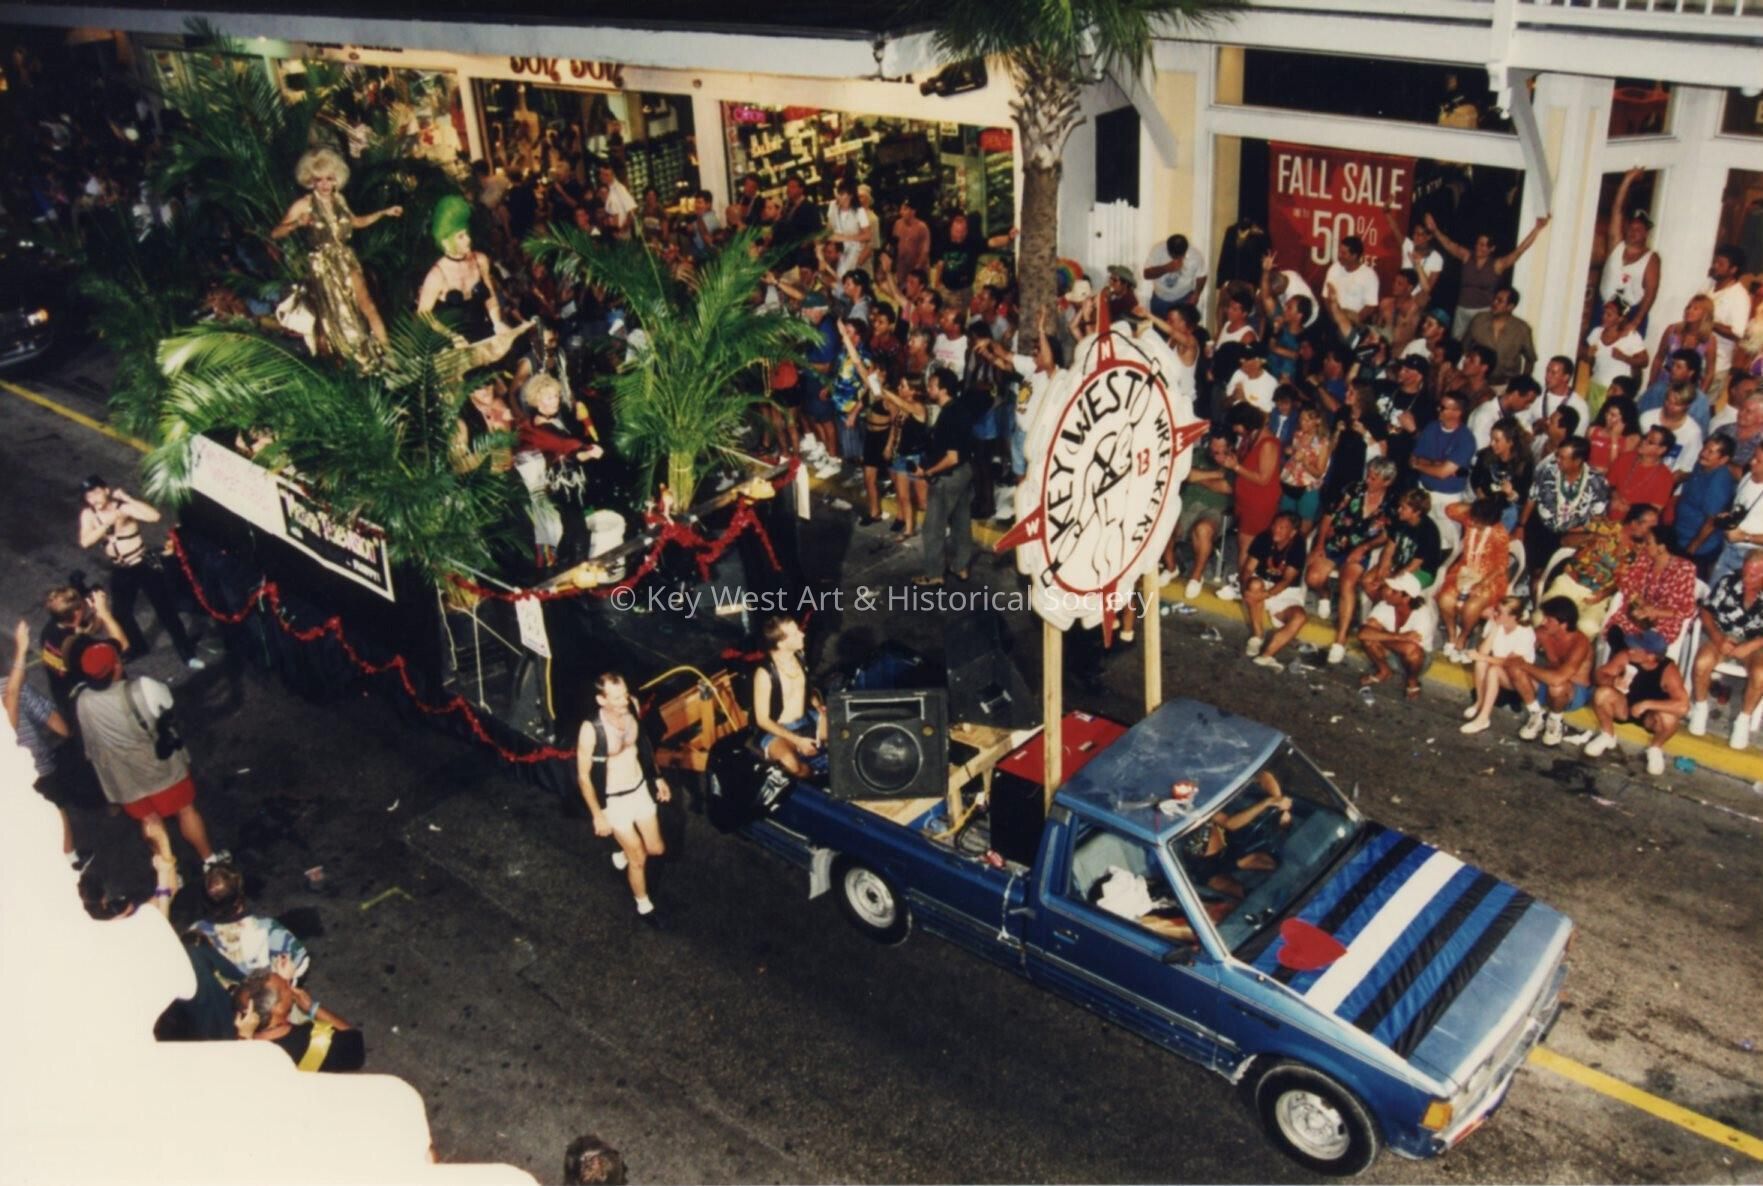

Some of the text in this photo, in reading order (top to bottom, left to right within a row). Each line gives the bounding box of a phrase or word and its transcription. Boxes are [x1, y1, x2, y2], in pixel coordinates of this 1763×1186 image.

[1277, 153, 1406, 210] FALL SALE
[1101, 340, 1111, 361] N
[1176, 431, 1184, 452] E
[1047, 368, 1144, 544] KEY WEST
[1136, 447, 1150, 477] 13
[1025, 517, 1040, 537] W
